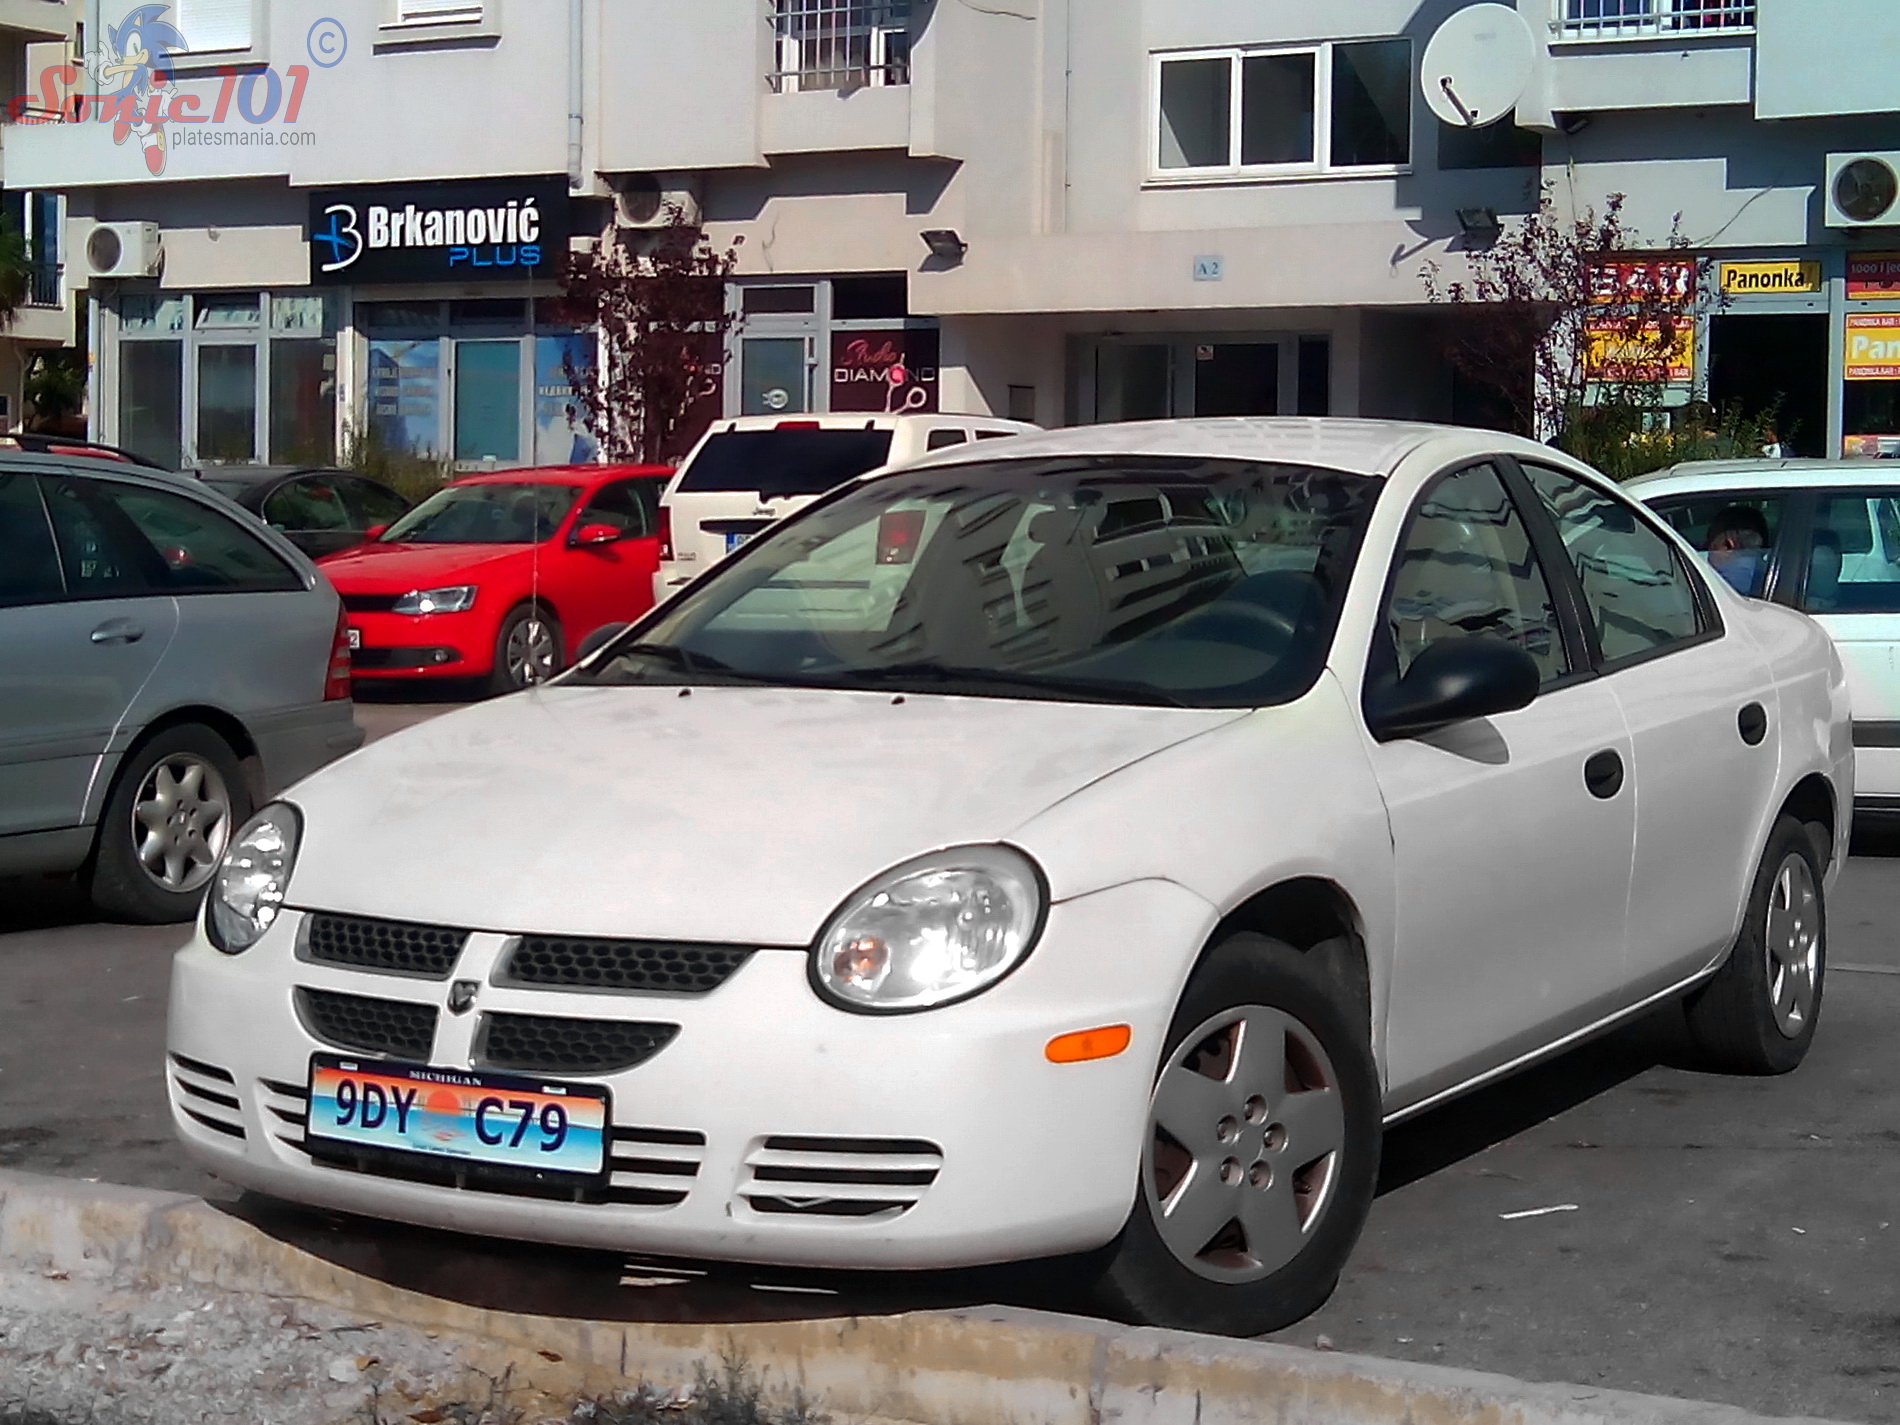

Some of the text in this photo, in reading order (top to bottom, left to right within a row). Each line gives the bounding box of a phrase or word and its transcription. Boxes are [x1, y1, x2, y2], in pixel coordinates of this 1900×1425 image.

[368, 197, 540, 249] Brkanović
[449, 245, 541, 267] PLUS
[1726, 268, 1805, 289] Panonka
[409, 1070, 483, 1087] MICHIGAN
[335, 1078, 569, 1152] 9DY C79
